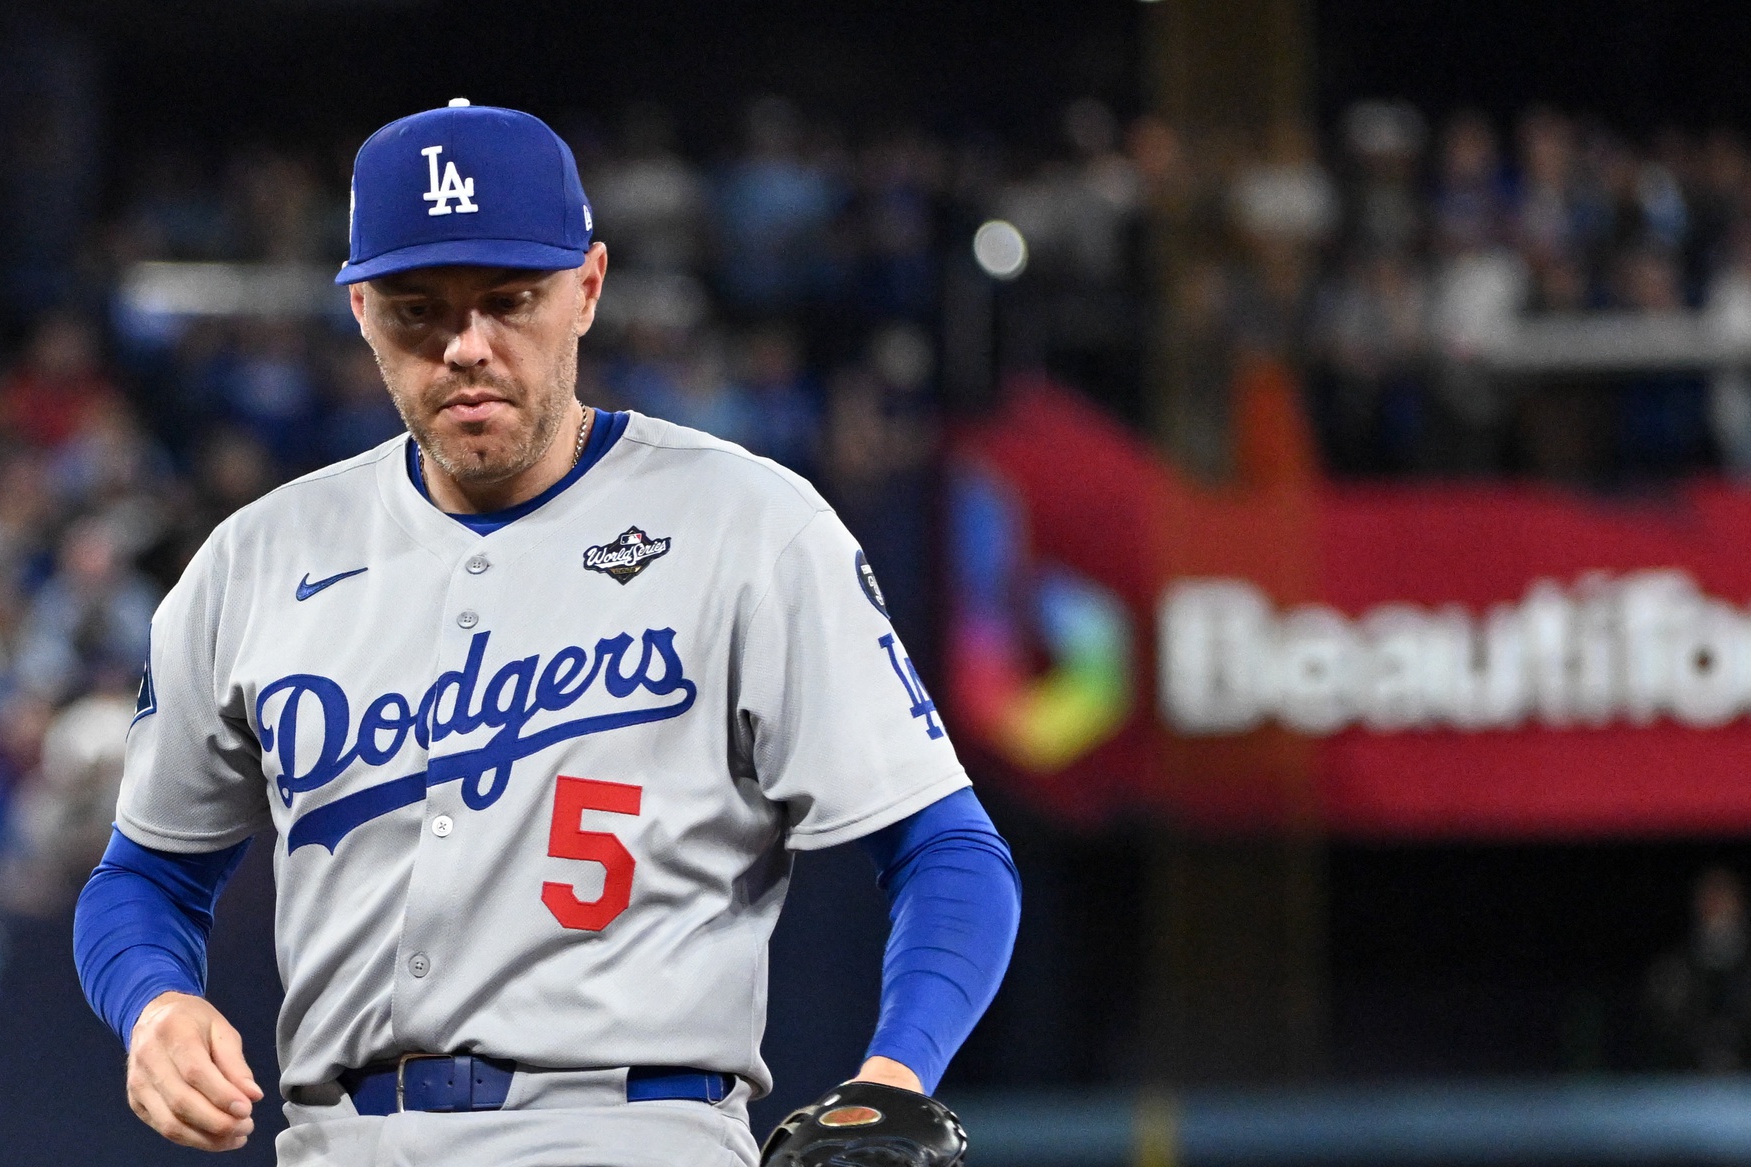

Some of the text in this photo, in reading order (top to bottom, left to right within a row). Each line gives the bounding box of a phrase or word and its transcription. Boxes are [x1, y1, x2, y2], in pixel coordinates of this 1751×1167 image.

[421, 145, 479, 216] LA
[587, 540, 667, 567] World Series
[256, 627, 697, 811] Dodgers
[541, 776, 643, 931] 5
